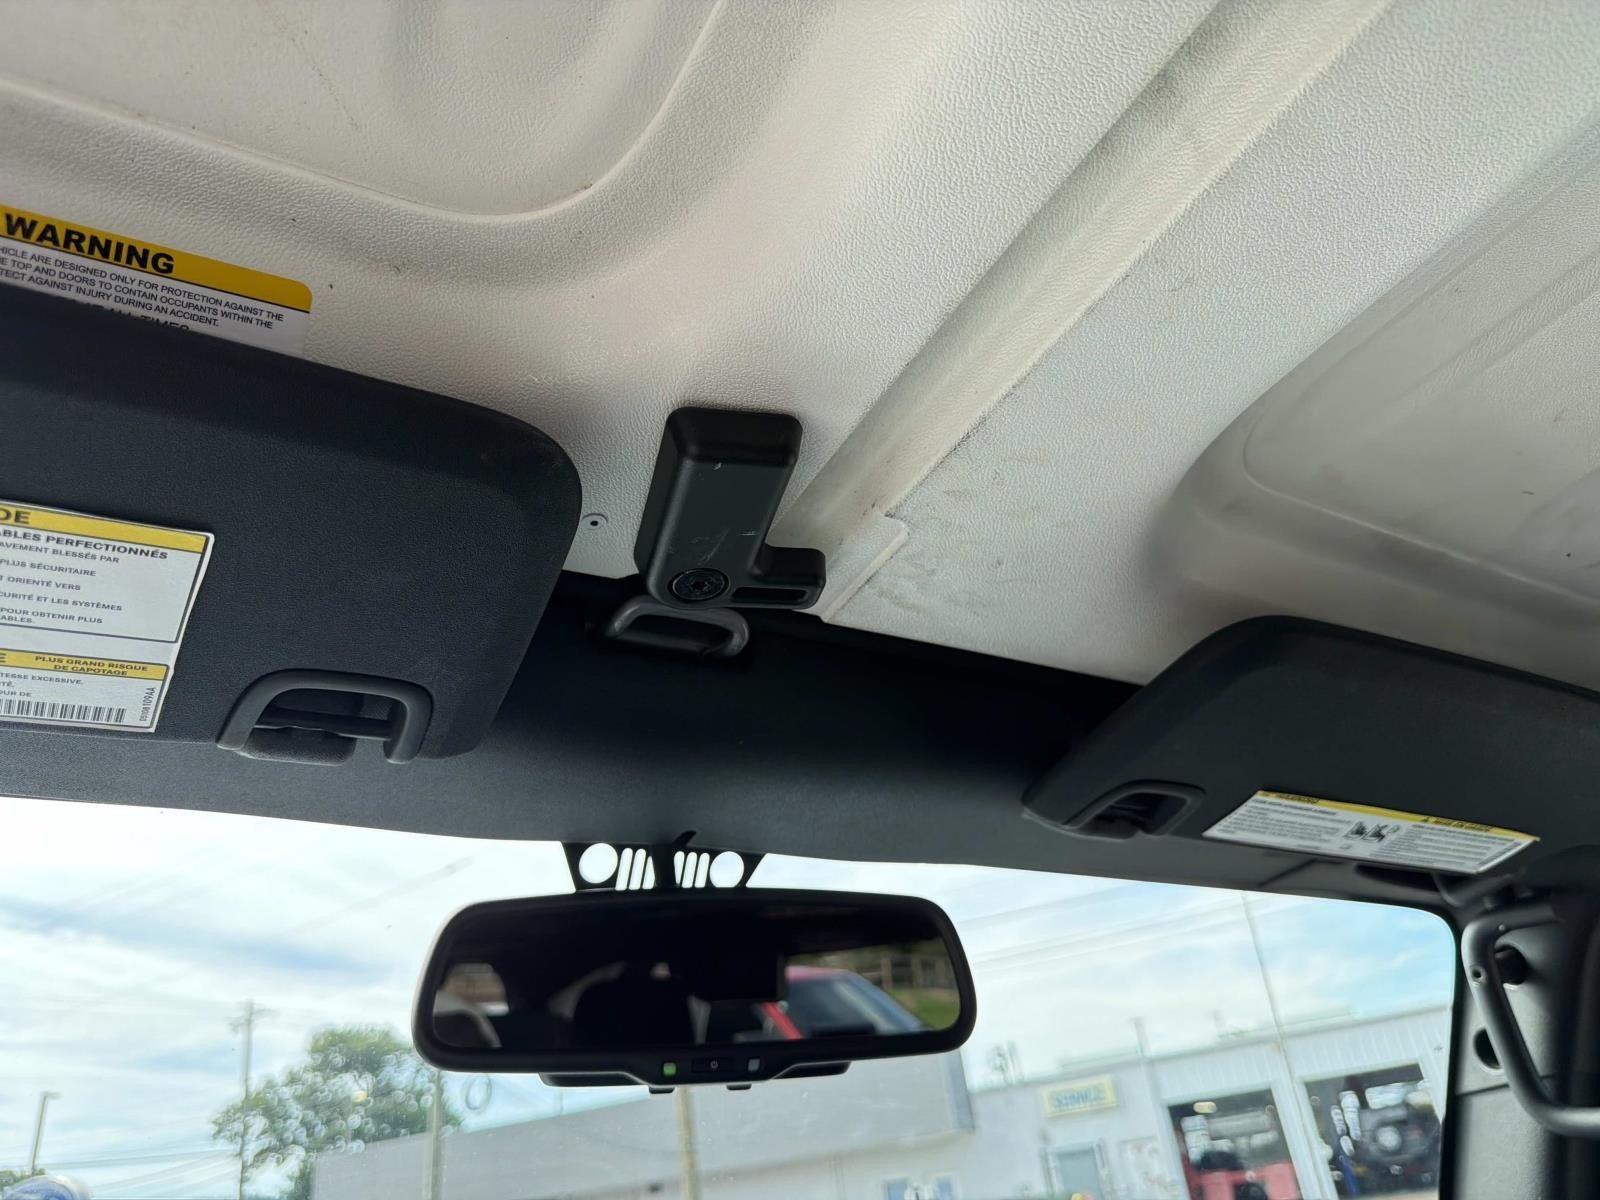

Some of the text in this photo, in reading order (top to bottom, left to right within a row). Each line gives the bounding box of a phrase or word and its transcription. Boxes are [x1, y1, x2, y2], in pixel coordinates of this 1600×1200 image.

[5, 213, 174, 274] WARNING
[11, 259, 32, 272] TOP
[33, 265, 56, 277] AND
[58, 271, 96, 287] DOORS
[98, 281, 112, 291] TO
[114, 284, 158, 301] CONTAIN
[160, 295, 218, 316] OCCUPANTS
[221, 310, 253, 325] WITHIN
[255, 318, 273, 330] THE
[30, 254, 52, 266] ARE
[54, 259, 107, 279] DESIGNED
[109, 272, 136, 286] ONLY
[138, 280, 159, 292] FOR
[161, 285, 222, 306] PROTECTION
[224, 301, 263, 317] AGAINST
[266, 310, 284, 322] THE
[27, 276, 74, 292] AGAINST
[76, 287, 113, 301] INJURY
[114, 295, 153, 311] DURING
[154, 305, 169, 316] AN
[169, 308, 219, 326] ACCIDENT.
[0, 529, 168, 559] BLES PERFECTIONNÉS
[52, 548, 97, 561] BLESSÉS
[100, 555, 119, 564] PAR
[30, 563, 96, 576] SÉCURITAIRE
[7, 576, 53, 587] ORIENTÉ
[55, 582, 81, 591] VERS
[1, 608, 102, 624] POUR OBTENIR PLUS
[66, 659, 105, 667] GRAND
[108, 662, 148, 671] RISQUE
[71, 666, 127, 676] CAPOTAGE
